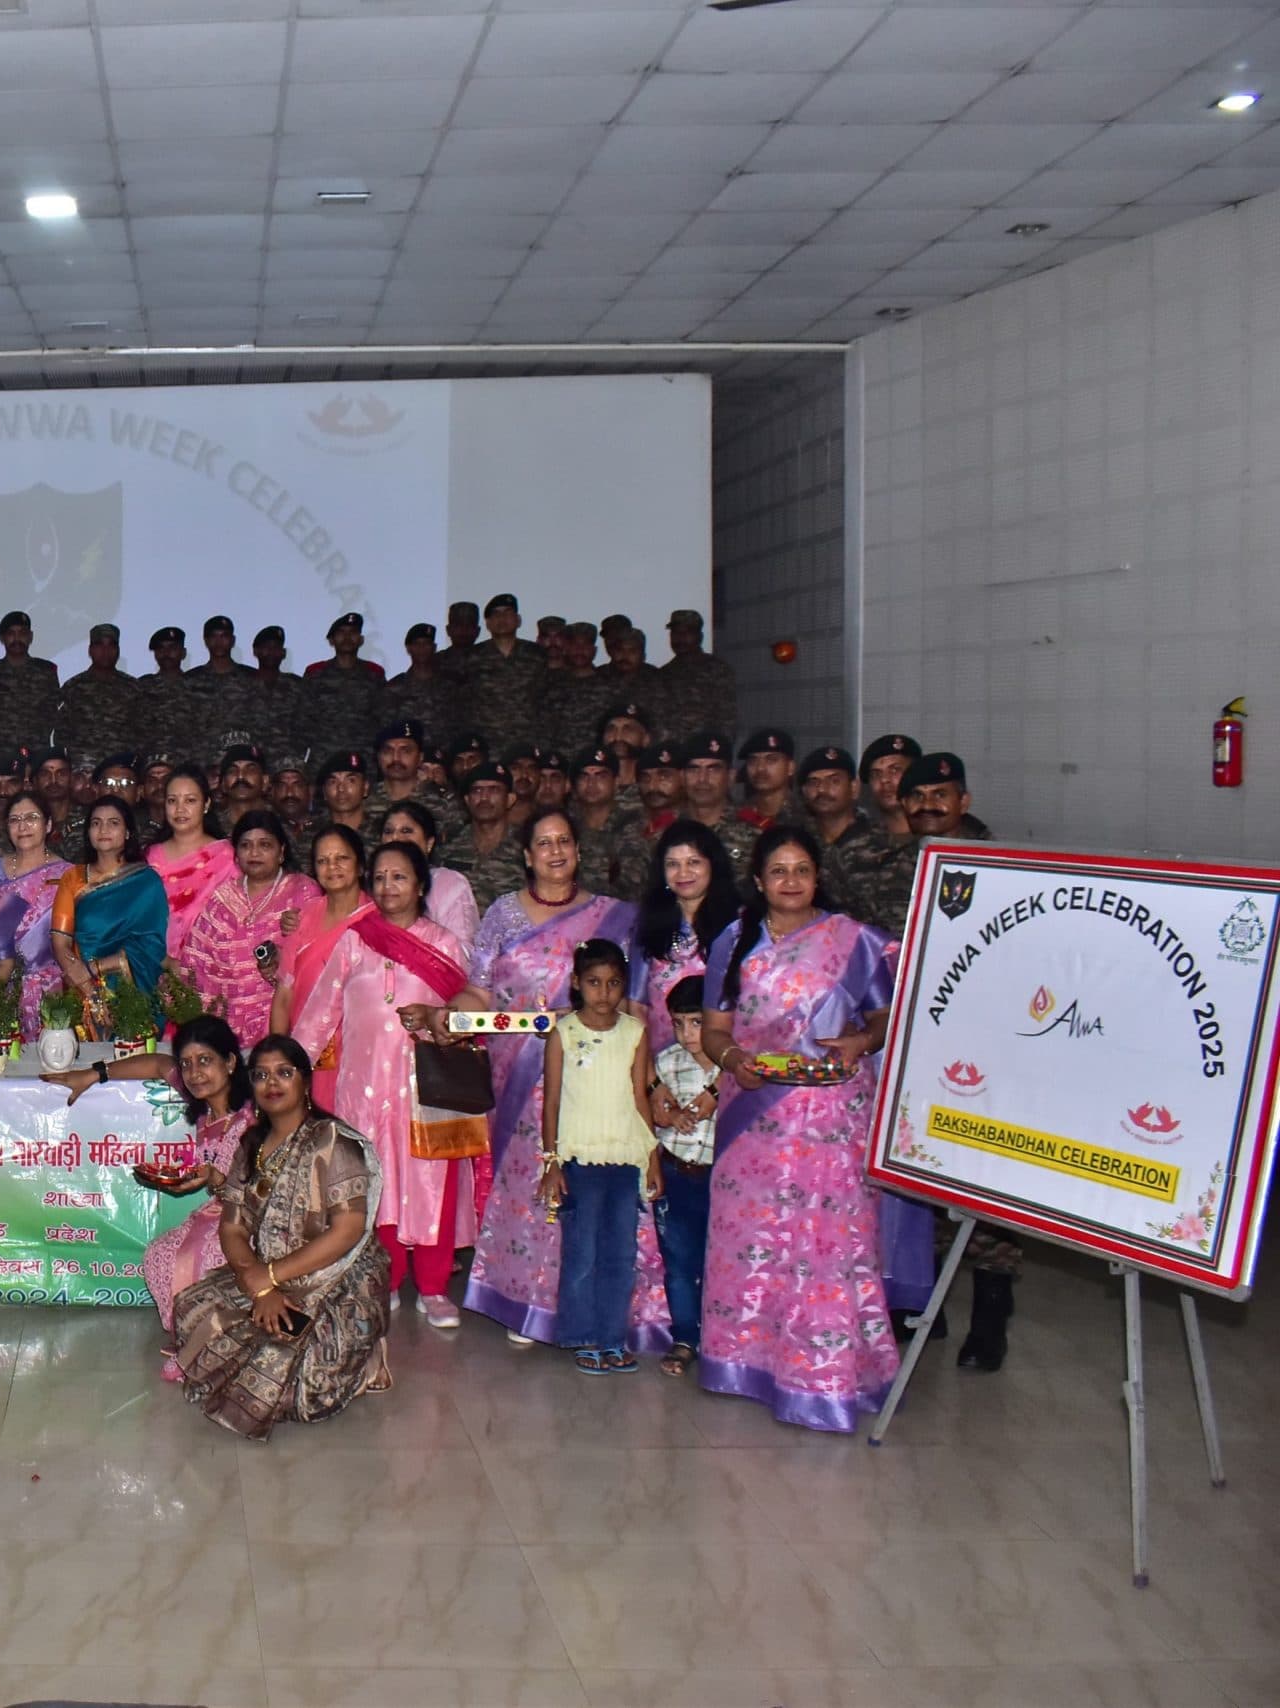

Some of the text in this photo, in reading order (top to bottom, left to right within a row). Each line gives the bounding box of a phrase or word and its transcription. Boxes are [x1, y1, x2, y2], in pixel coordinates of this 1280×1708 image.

[110, 408, 223, 480] WEEK
[928, 886, 1225, 1079] AWWA WEEK CELEBRATION 2025
[88, 1133, 146, 1167] महिला
[934, 1112, 1171, 1188] RAKSHABANDHAN CELEBRATION
[43, 1191, 104, 1207] शाखा
[46, 1223, 97, 1242] प्रदेश
[53, 1259, 145, 1277] 26.10.20
